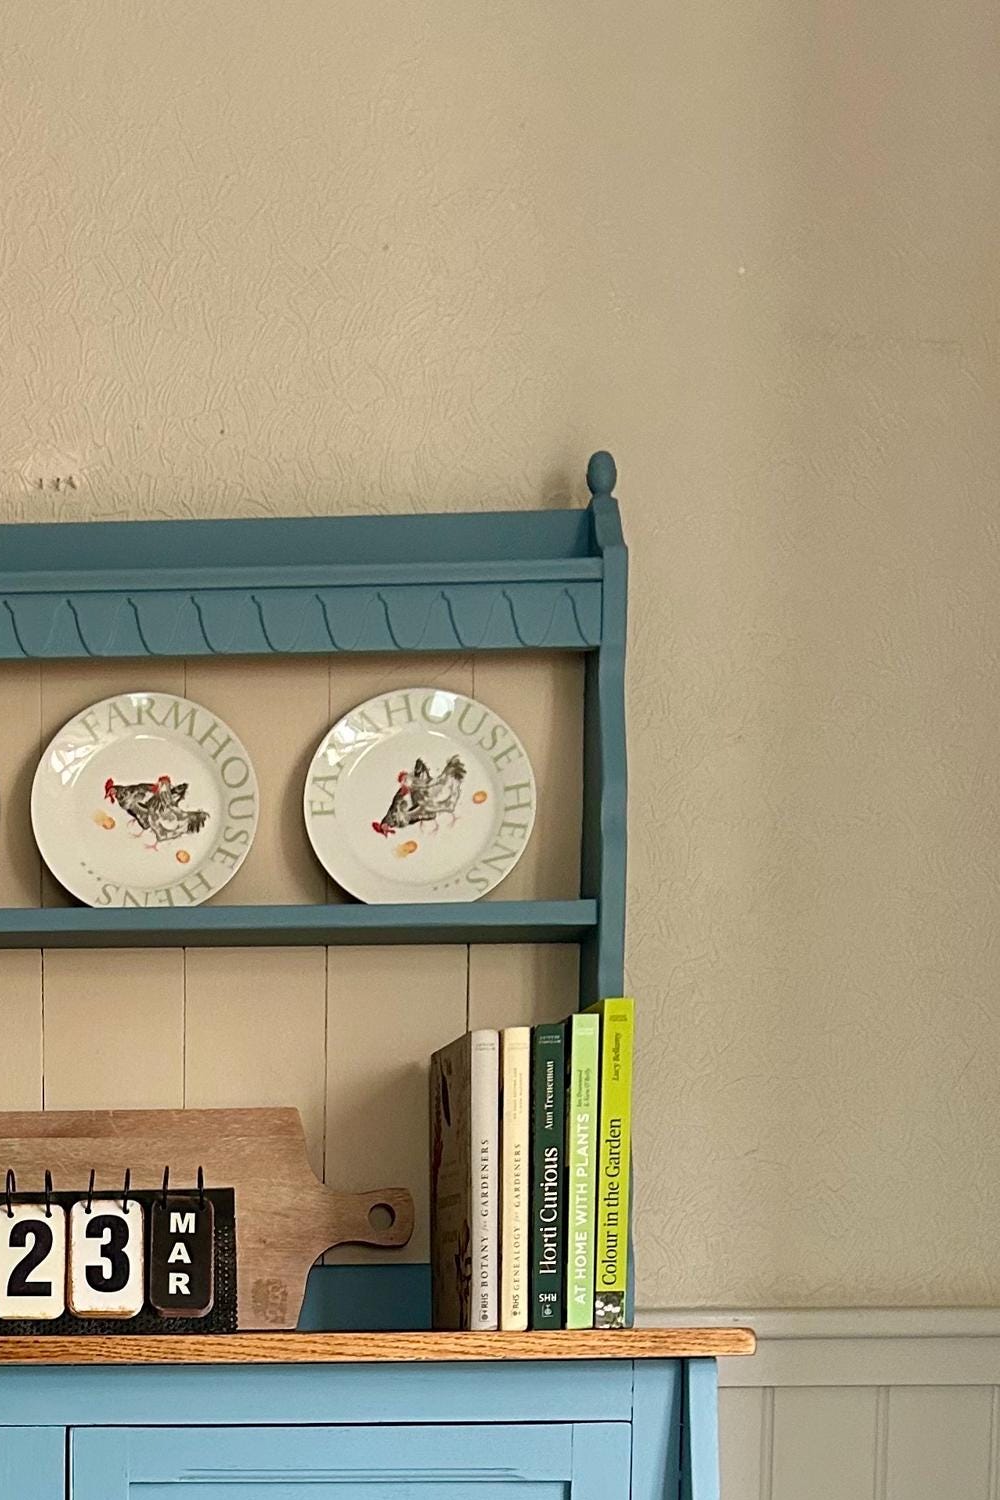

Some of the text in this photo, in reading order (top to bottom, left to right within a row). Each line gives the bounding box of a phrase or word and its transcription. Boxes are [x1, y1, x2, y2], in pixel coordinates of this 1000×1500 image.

[79, 698, 256, 870] FARMHOUSE
[611, 1063, 621, 1081] Lucy
[544, 1111, 554, 1130] Ann
[576, 1113, 590, 1177] PLANTS
[481, 1139, 489, 1217] GARDENERS
[513, 1143, 521, 1208] GARDENERS
[575, 1183, 588, 1226] WITH
[602, 1118, 622, 1285] Colour in the Garden
[539, 1147, 558, 1274] Horti Curious
[167, 1212, 196, 1296] MAR
[481, 1235, 489, 1288] BOTANY
[513, 1226, 521, 1291] GENEALOGY
[574, 1231, 588, 1279] HOME
[481, 1293, 489, 1309] RHS
[539, 1293, 557, 1302] RHS
[574, 1284, 586, 1305] AT
